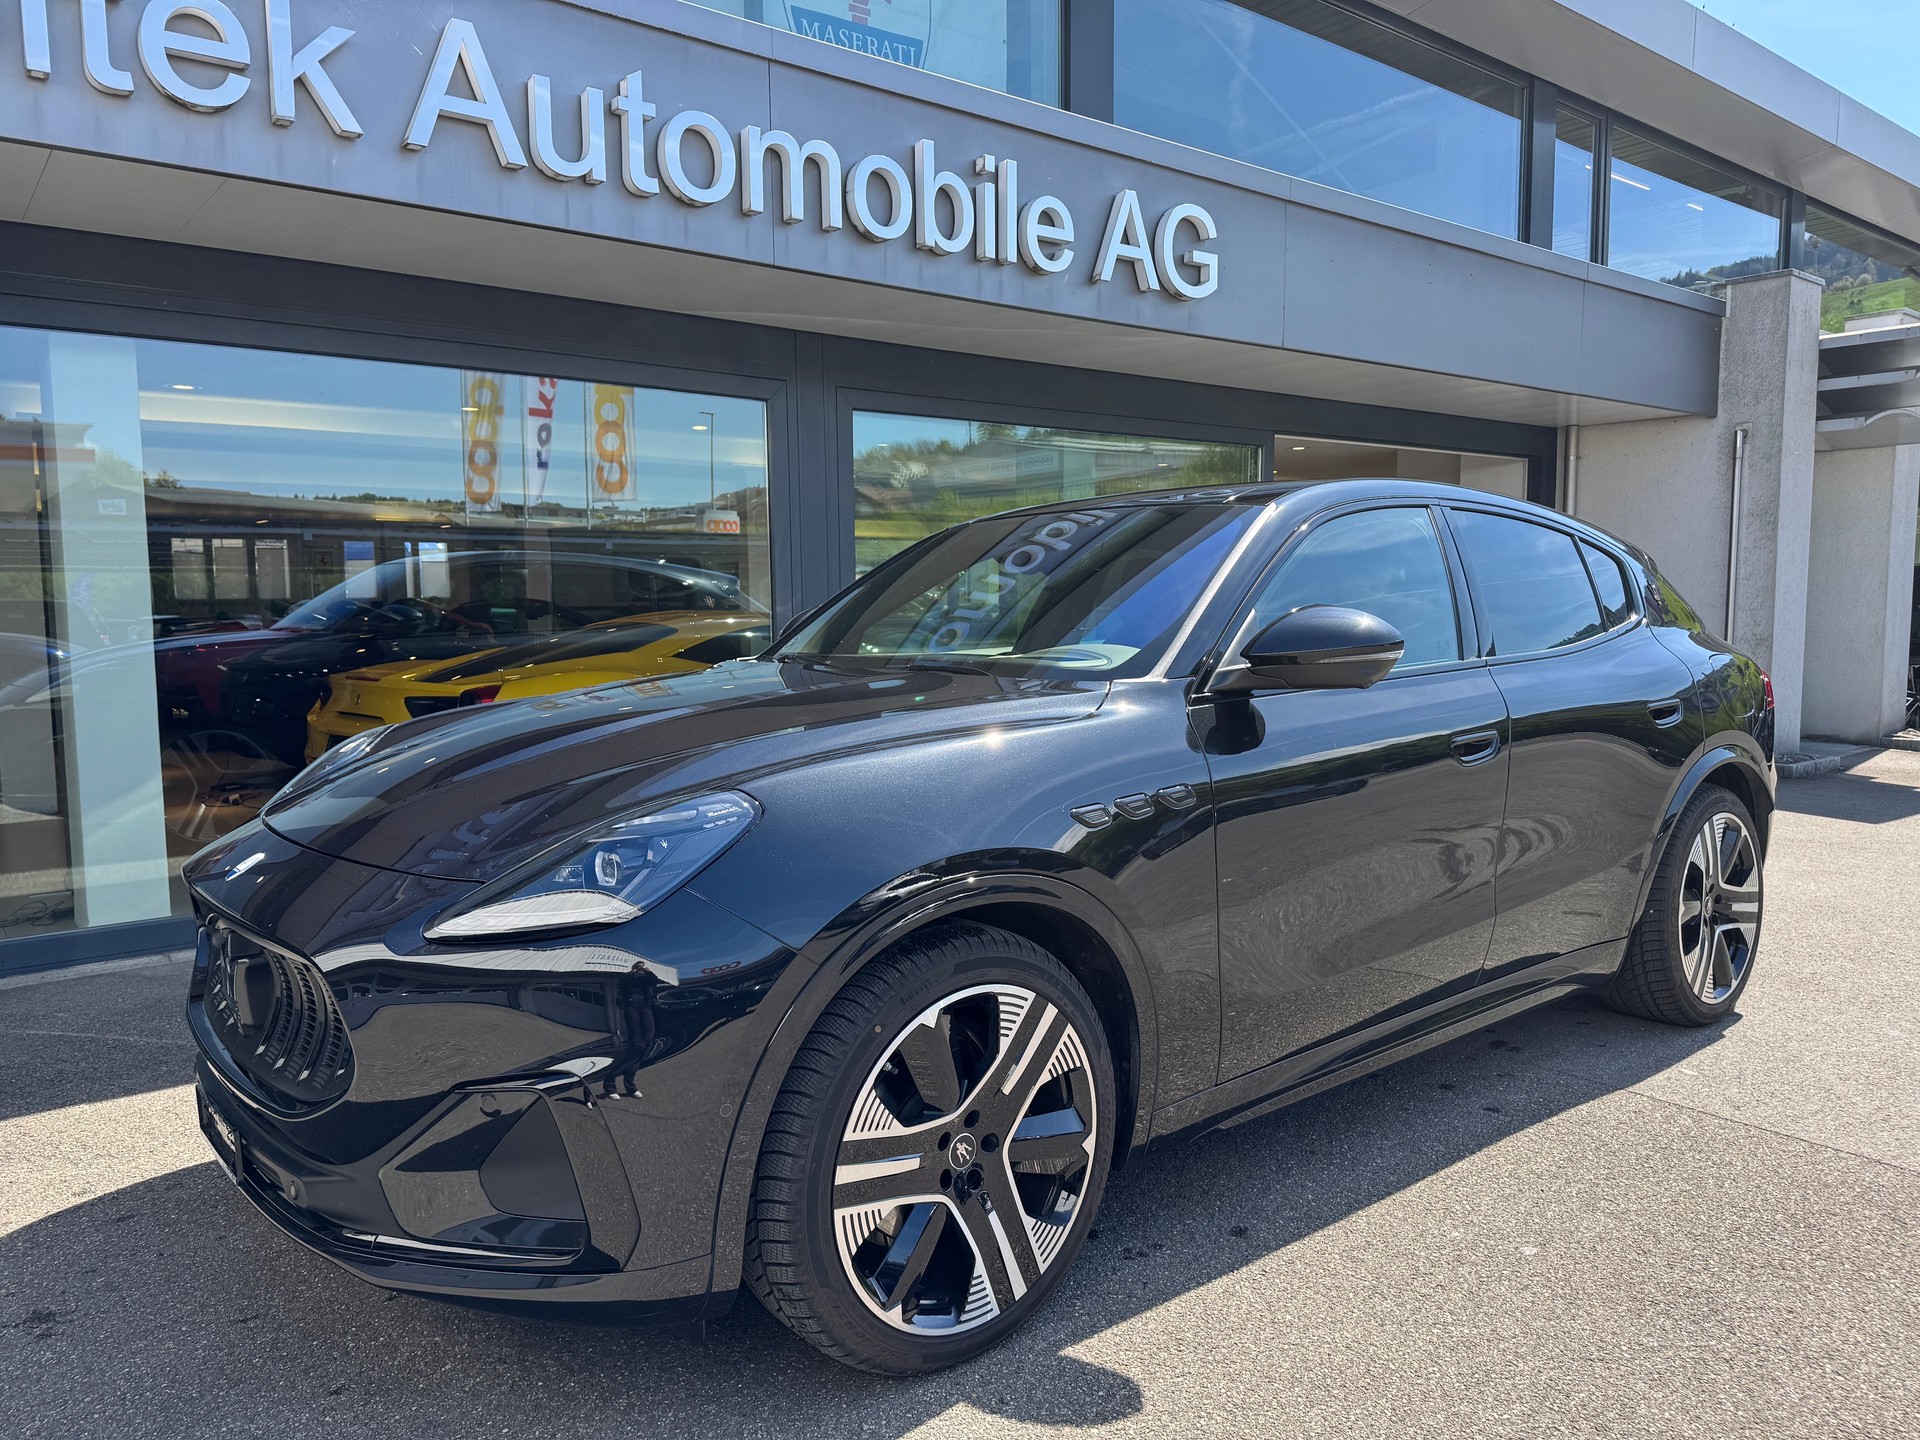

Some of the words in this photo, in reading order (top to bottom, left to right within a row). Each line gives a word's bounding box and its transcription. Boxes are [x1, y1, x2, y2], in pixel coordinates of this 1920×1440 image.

[800, 18, 917, 67] MASERATI
[402, 18, 1075, 275] Automobile
[1091, 189, 1219, 300] AG
